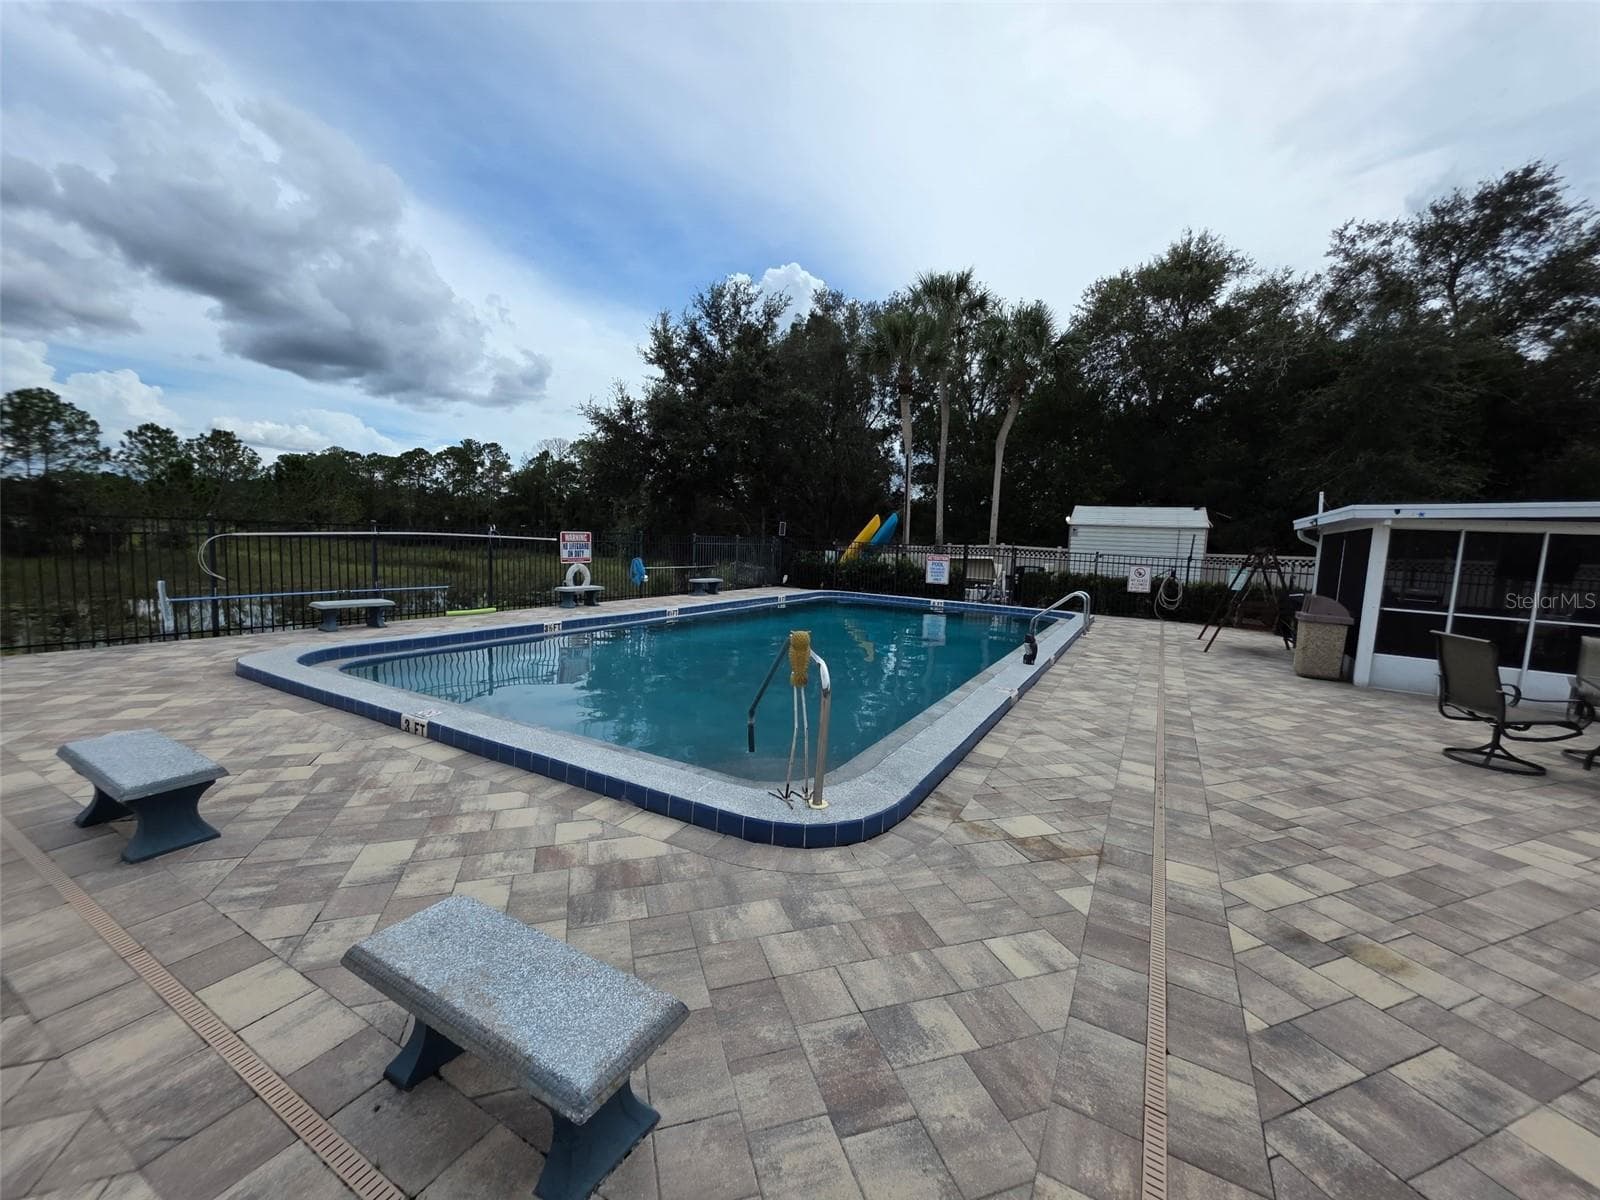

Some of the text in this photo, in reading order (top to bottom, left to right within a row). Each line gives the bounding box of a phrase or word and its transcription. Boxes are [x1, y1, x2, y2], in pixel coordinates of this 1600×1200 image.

[565, 533, 587, 541] WARNING
[404, 719, 425, 736] 3 FT
